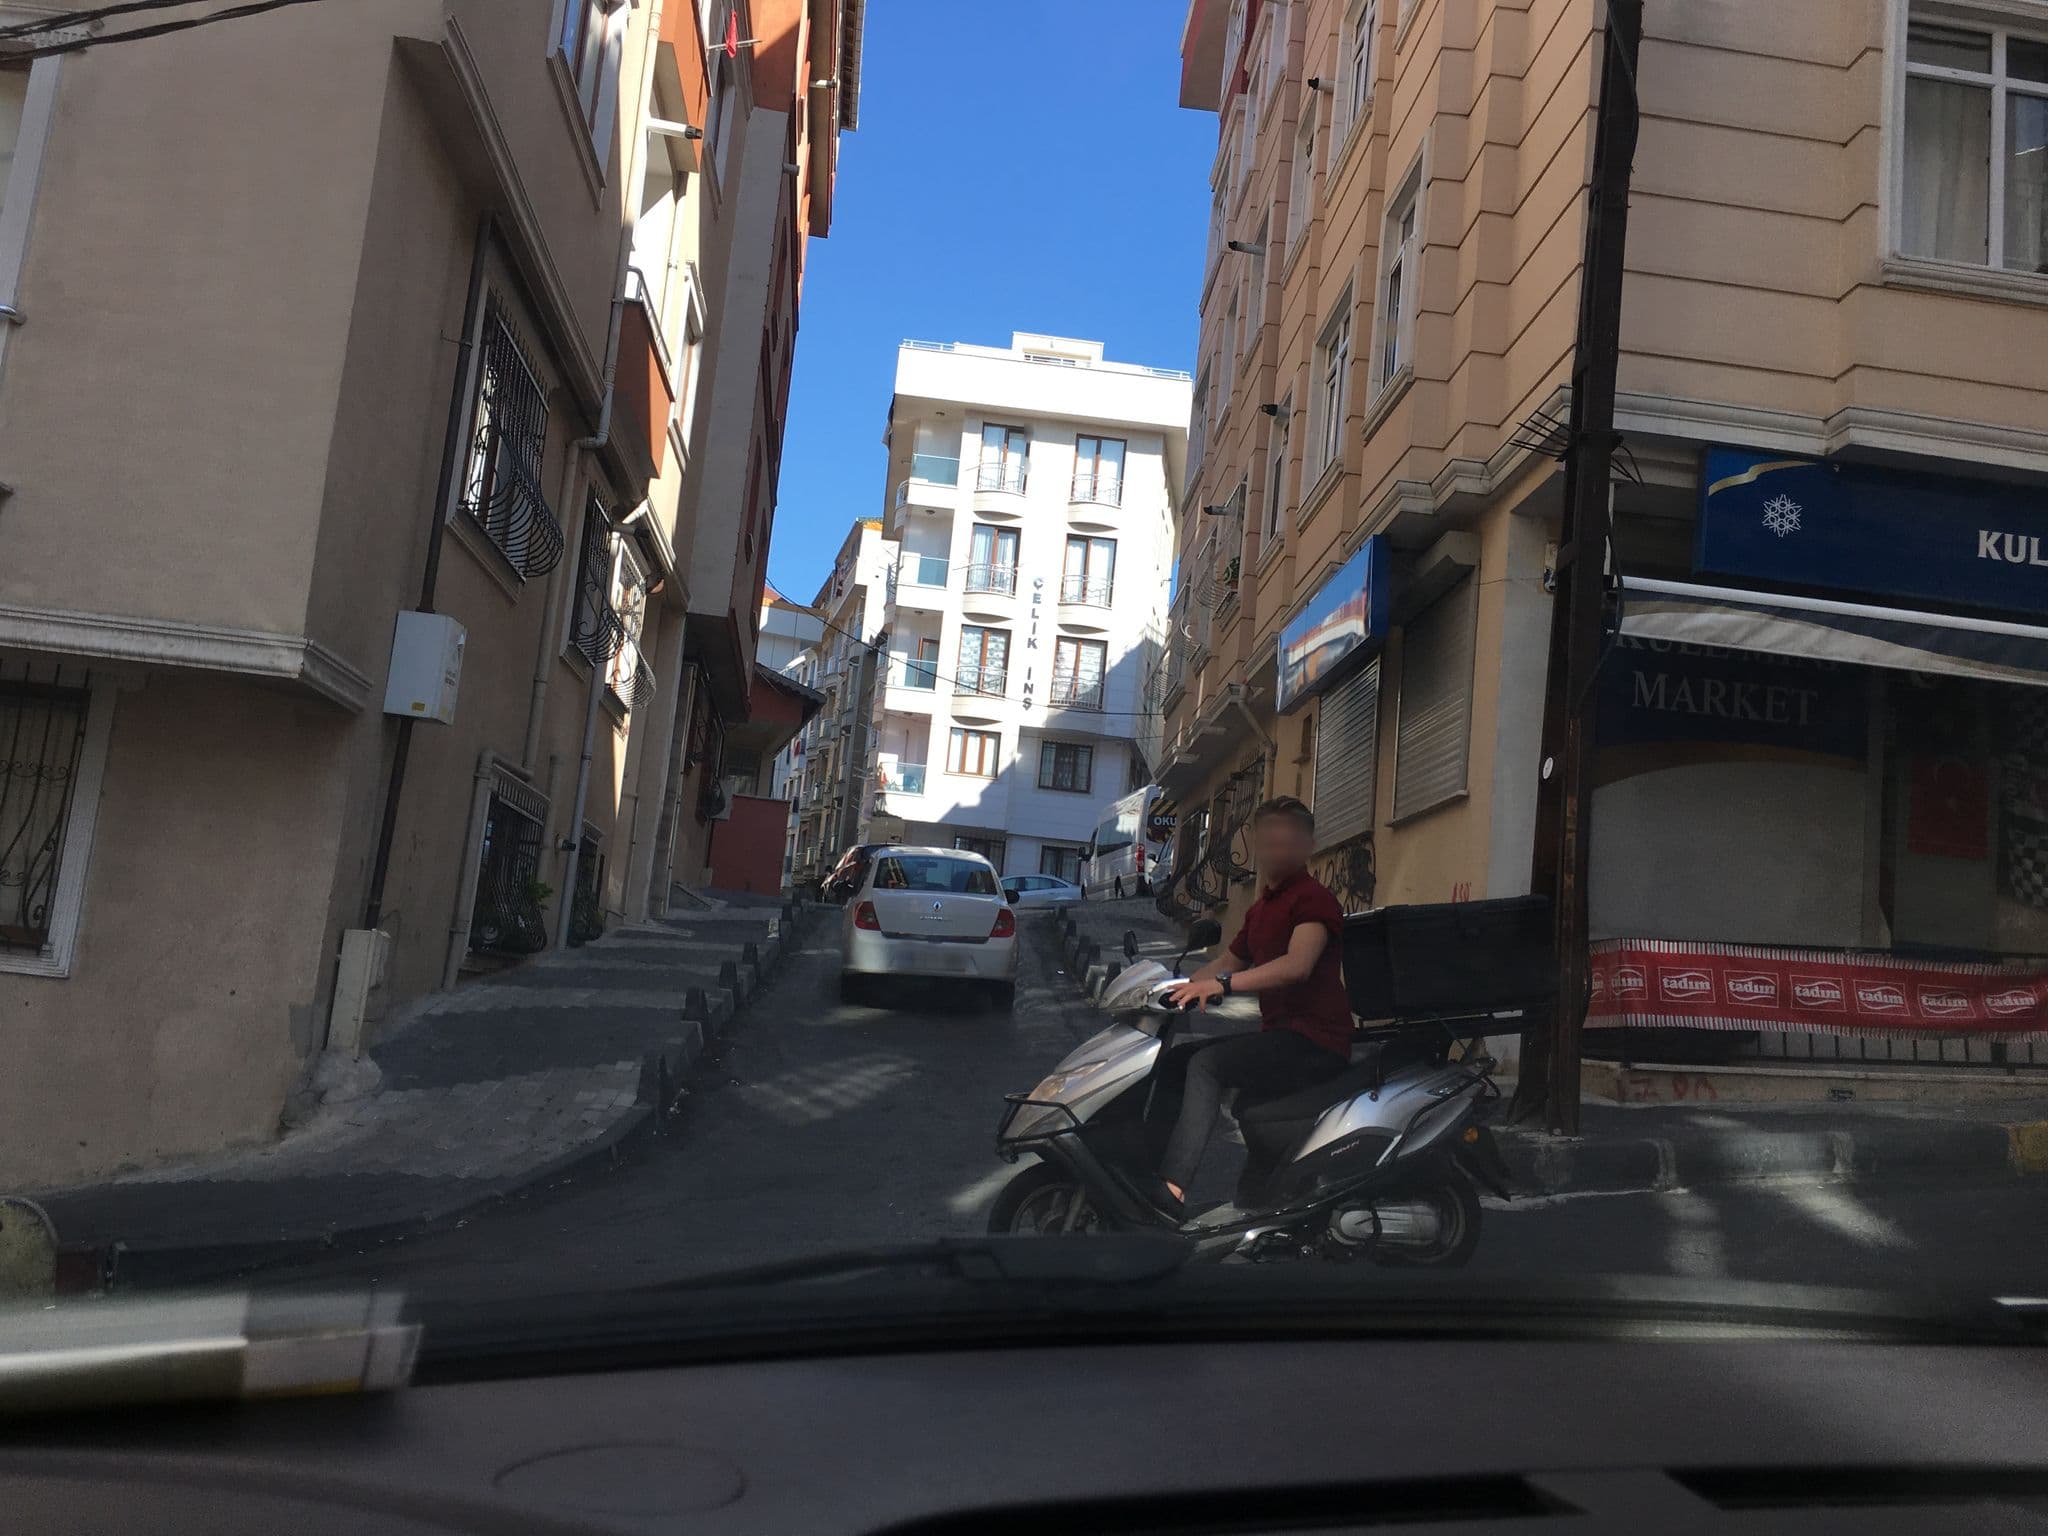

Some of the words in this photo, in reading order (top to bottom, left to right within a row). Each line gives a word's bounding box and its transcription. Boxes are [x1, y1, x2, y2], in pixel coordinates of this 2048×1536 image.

[1977, 530, 2048, 567] KUL
[1631, 670, 1819, 728] MARKET
[1662, 977, 1711, 991] tadım
[1728, 979, 1776, 994] tadım
[1794, 985, 1841, 999] tadım
[1858, 990, 1904, 1005] tadım
[1921, 995, 1968, 1007] tadım
